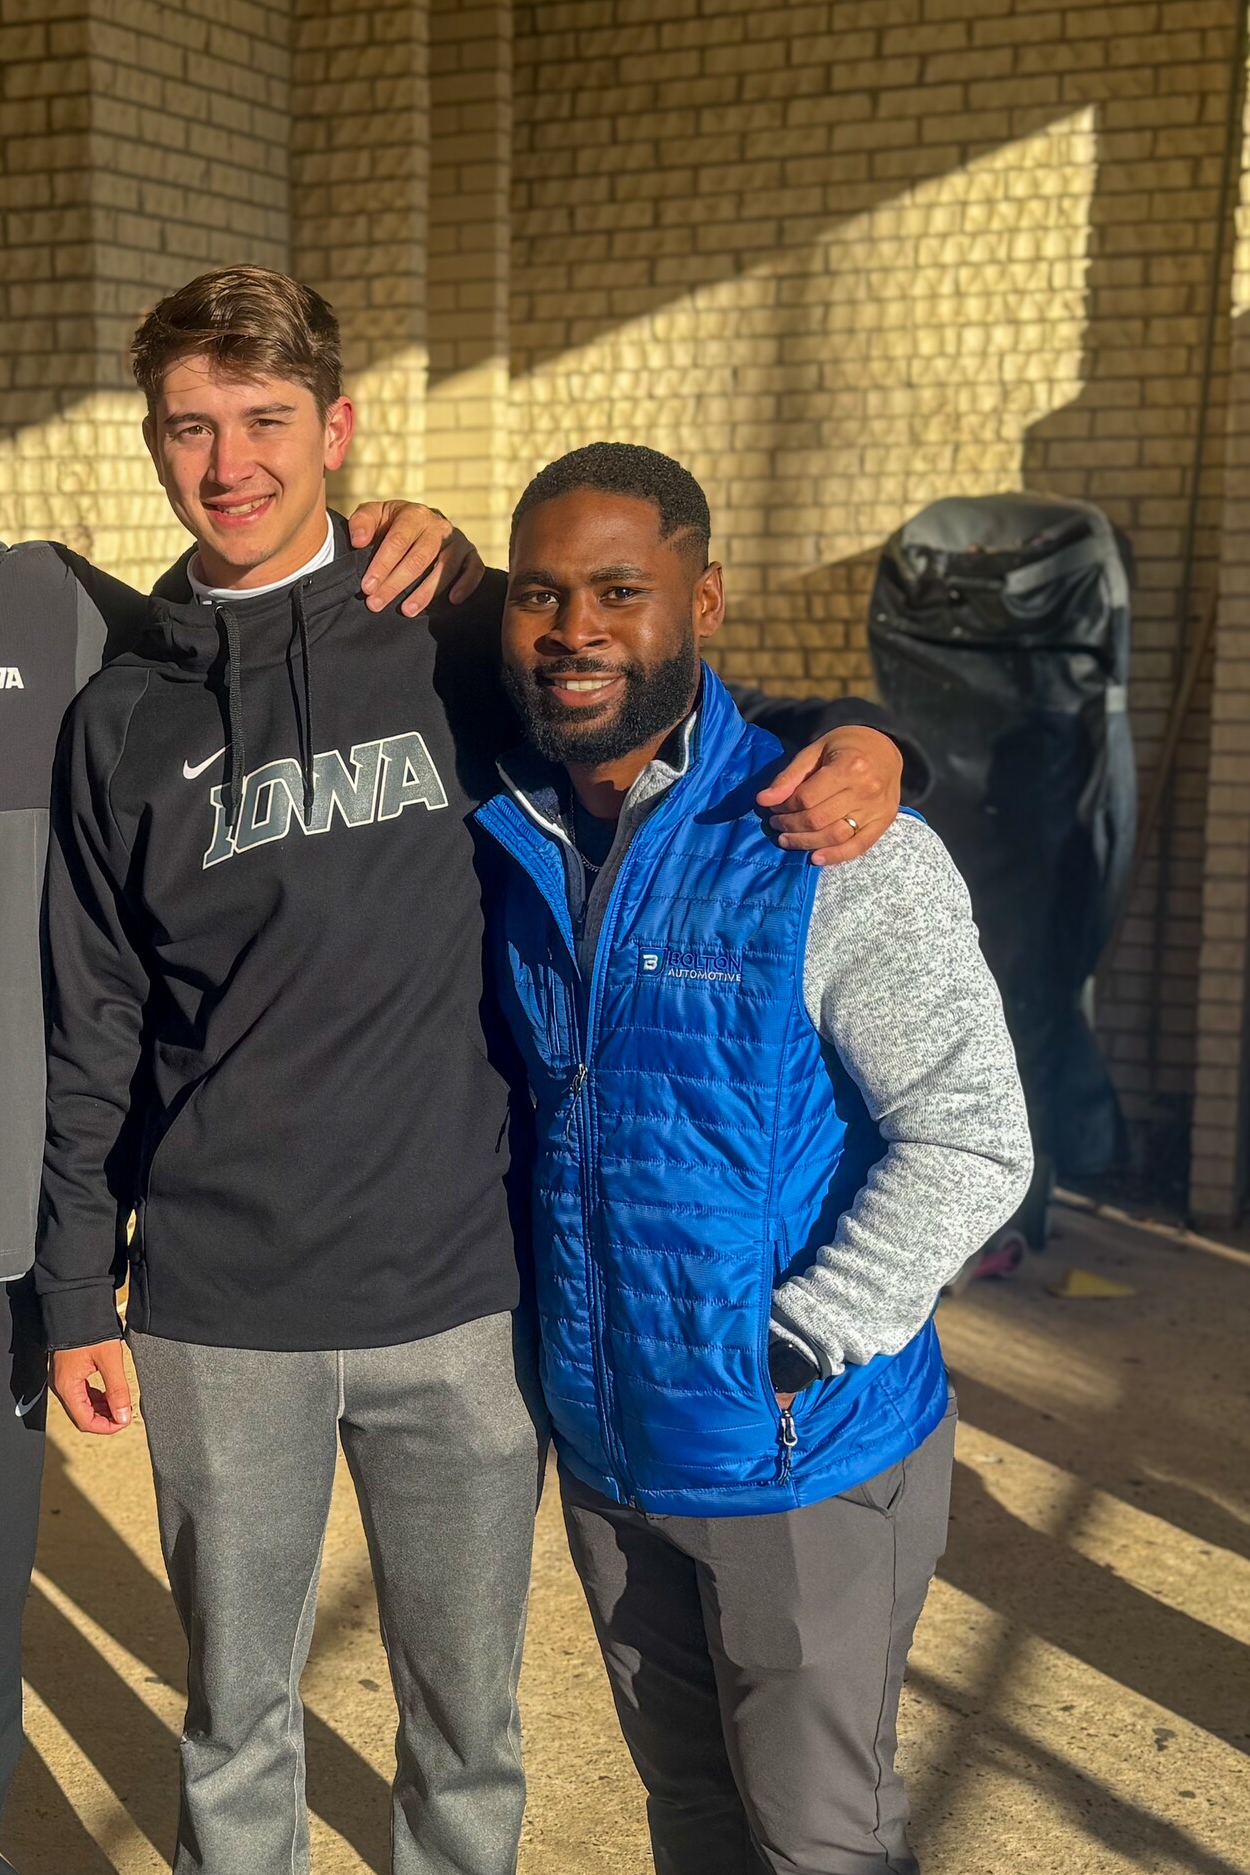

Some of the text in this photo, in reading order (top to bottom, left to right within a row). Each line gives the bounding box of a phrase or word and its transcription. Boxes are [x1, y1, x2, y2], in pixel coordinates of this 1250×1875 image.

[203, 731, 448, 869] IOWA
[669, 951, 742, 973] BOLTON
[668, 967, 742, 982] AUTOMOTIVE
